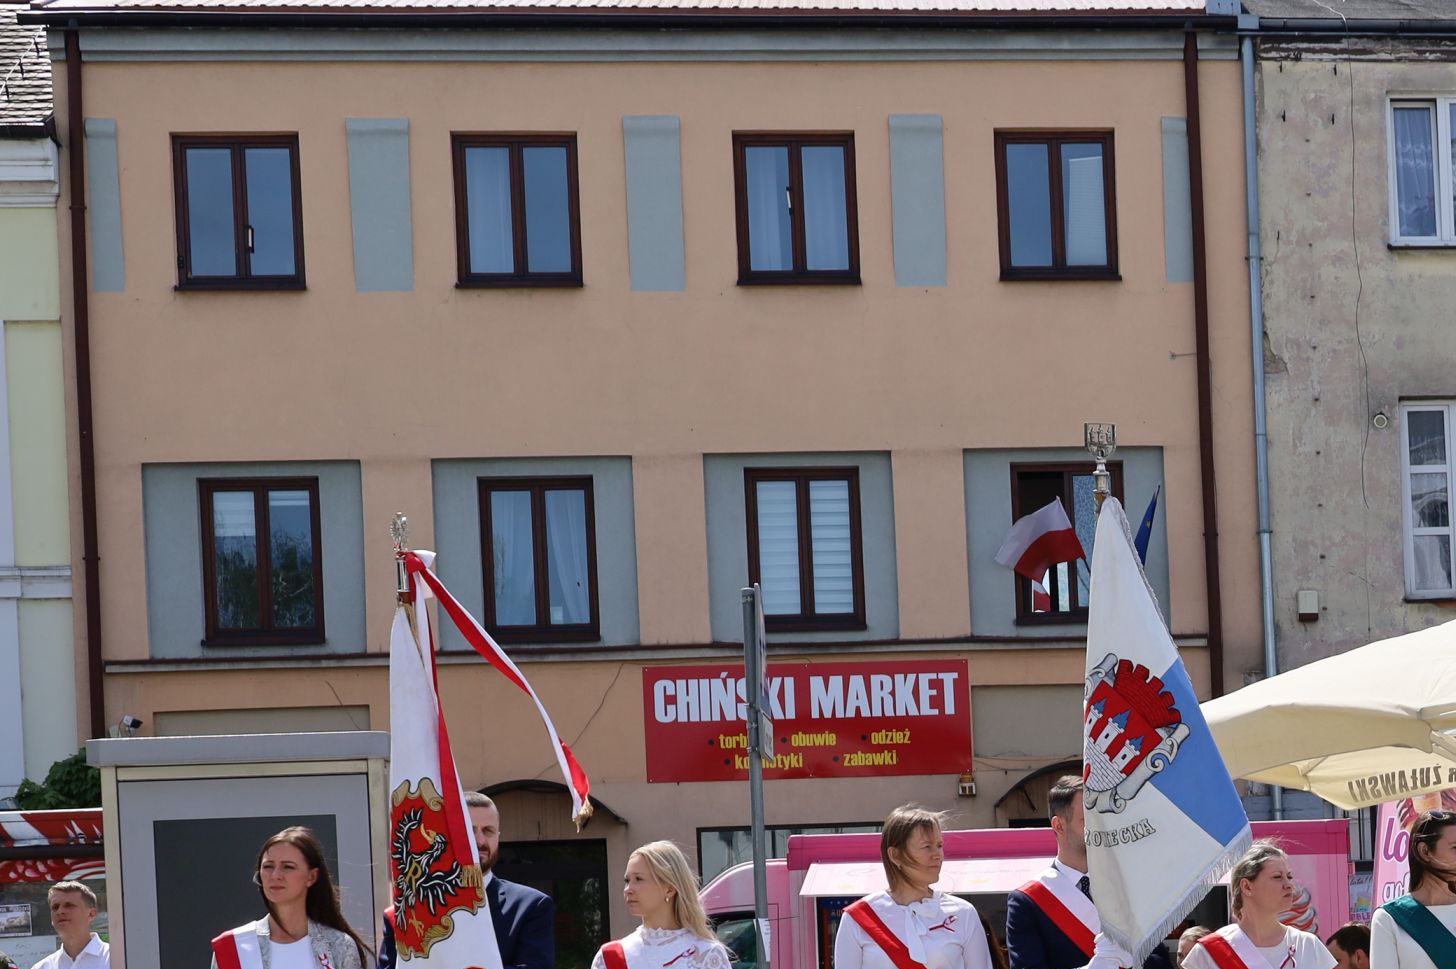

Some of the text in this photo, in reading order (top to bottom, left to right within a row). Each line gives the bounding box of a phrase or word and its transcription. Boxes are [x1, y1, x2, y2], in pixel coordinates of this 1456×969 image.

[810, 672, 958, 720] MARKET
[791, 731, 837, 748] obuwie
[870, 728, 911, 745] odzież
[843, 750, 897, 767] zabawki
[1383, 817, 1410, 862] lo
